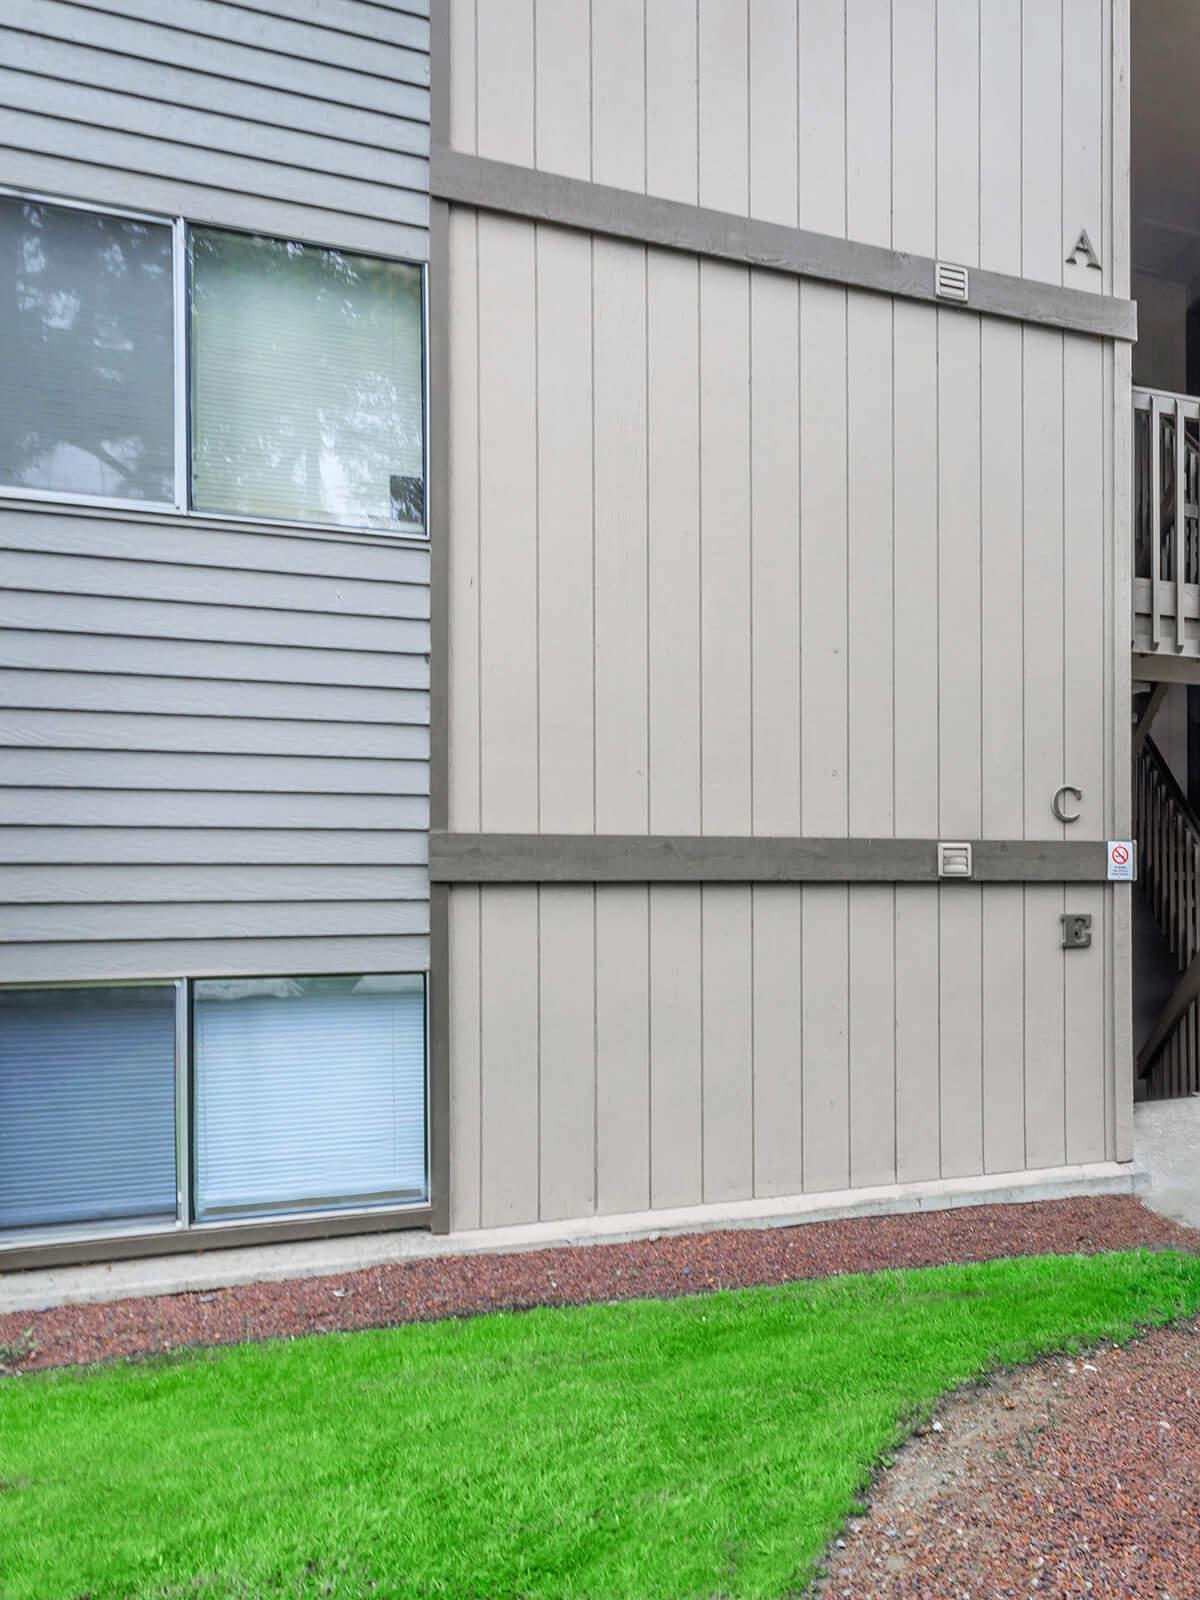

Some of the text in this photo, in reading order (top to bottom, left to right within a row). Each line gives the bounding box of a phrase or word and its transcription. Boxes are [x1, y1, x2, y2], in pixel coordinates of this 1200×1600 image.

[1065, 229, 1101, 271] A
[1051, 785, 1082, 823] C
[1061, 914, 1092, 949] E
